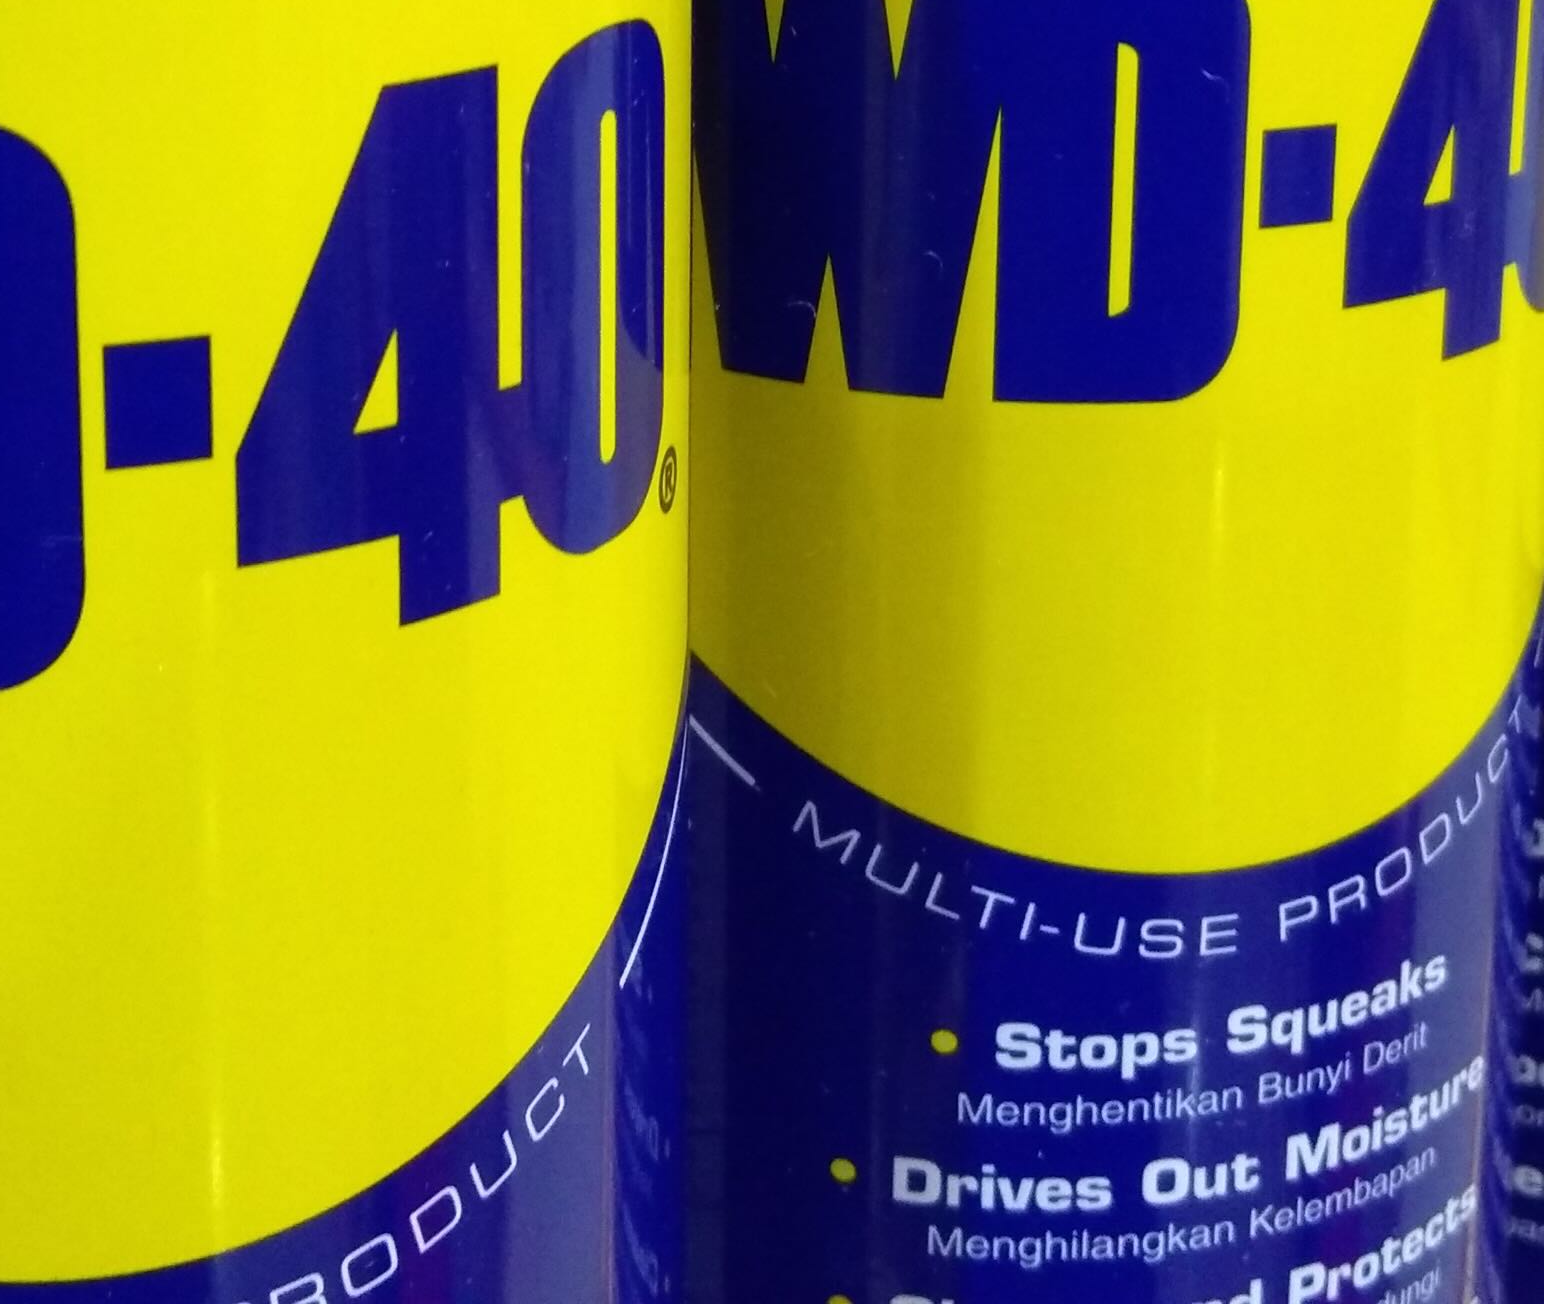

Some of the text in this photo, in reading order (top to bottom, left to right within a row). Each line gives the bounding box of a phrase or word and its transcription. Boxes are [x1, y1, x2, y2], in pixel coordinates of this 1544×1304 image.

[792, 694, 1524, 960] MULTI-USE PRODUCT
[957, 1021, 1430, 1136] Menghentikan Bunyi Derit
[995, 951, 1450, 1078] Stops Squeaks
[231, 1022, 592, 1304] RODUCT
[892, 1054, 1487, 1213] Drives Out Moisture
[926, 1223, 1236, 1271] Menghilangkan
[1250, 1143, 1438, 1241] Kelembapan
[1287, 1182, 1478, 1304] Protects
